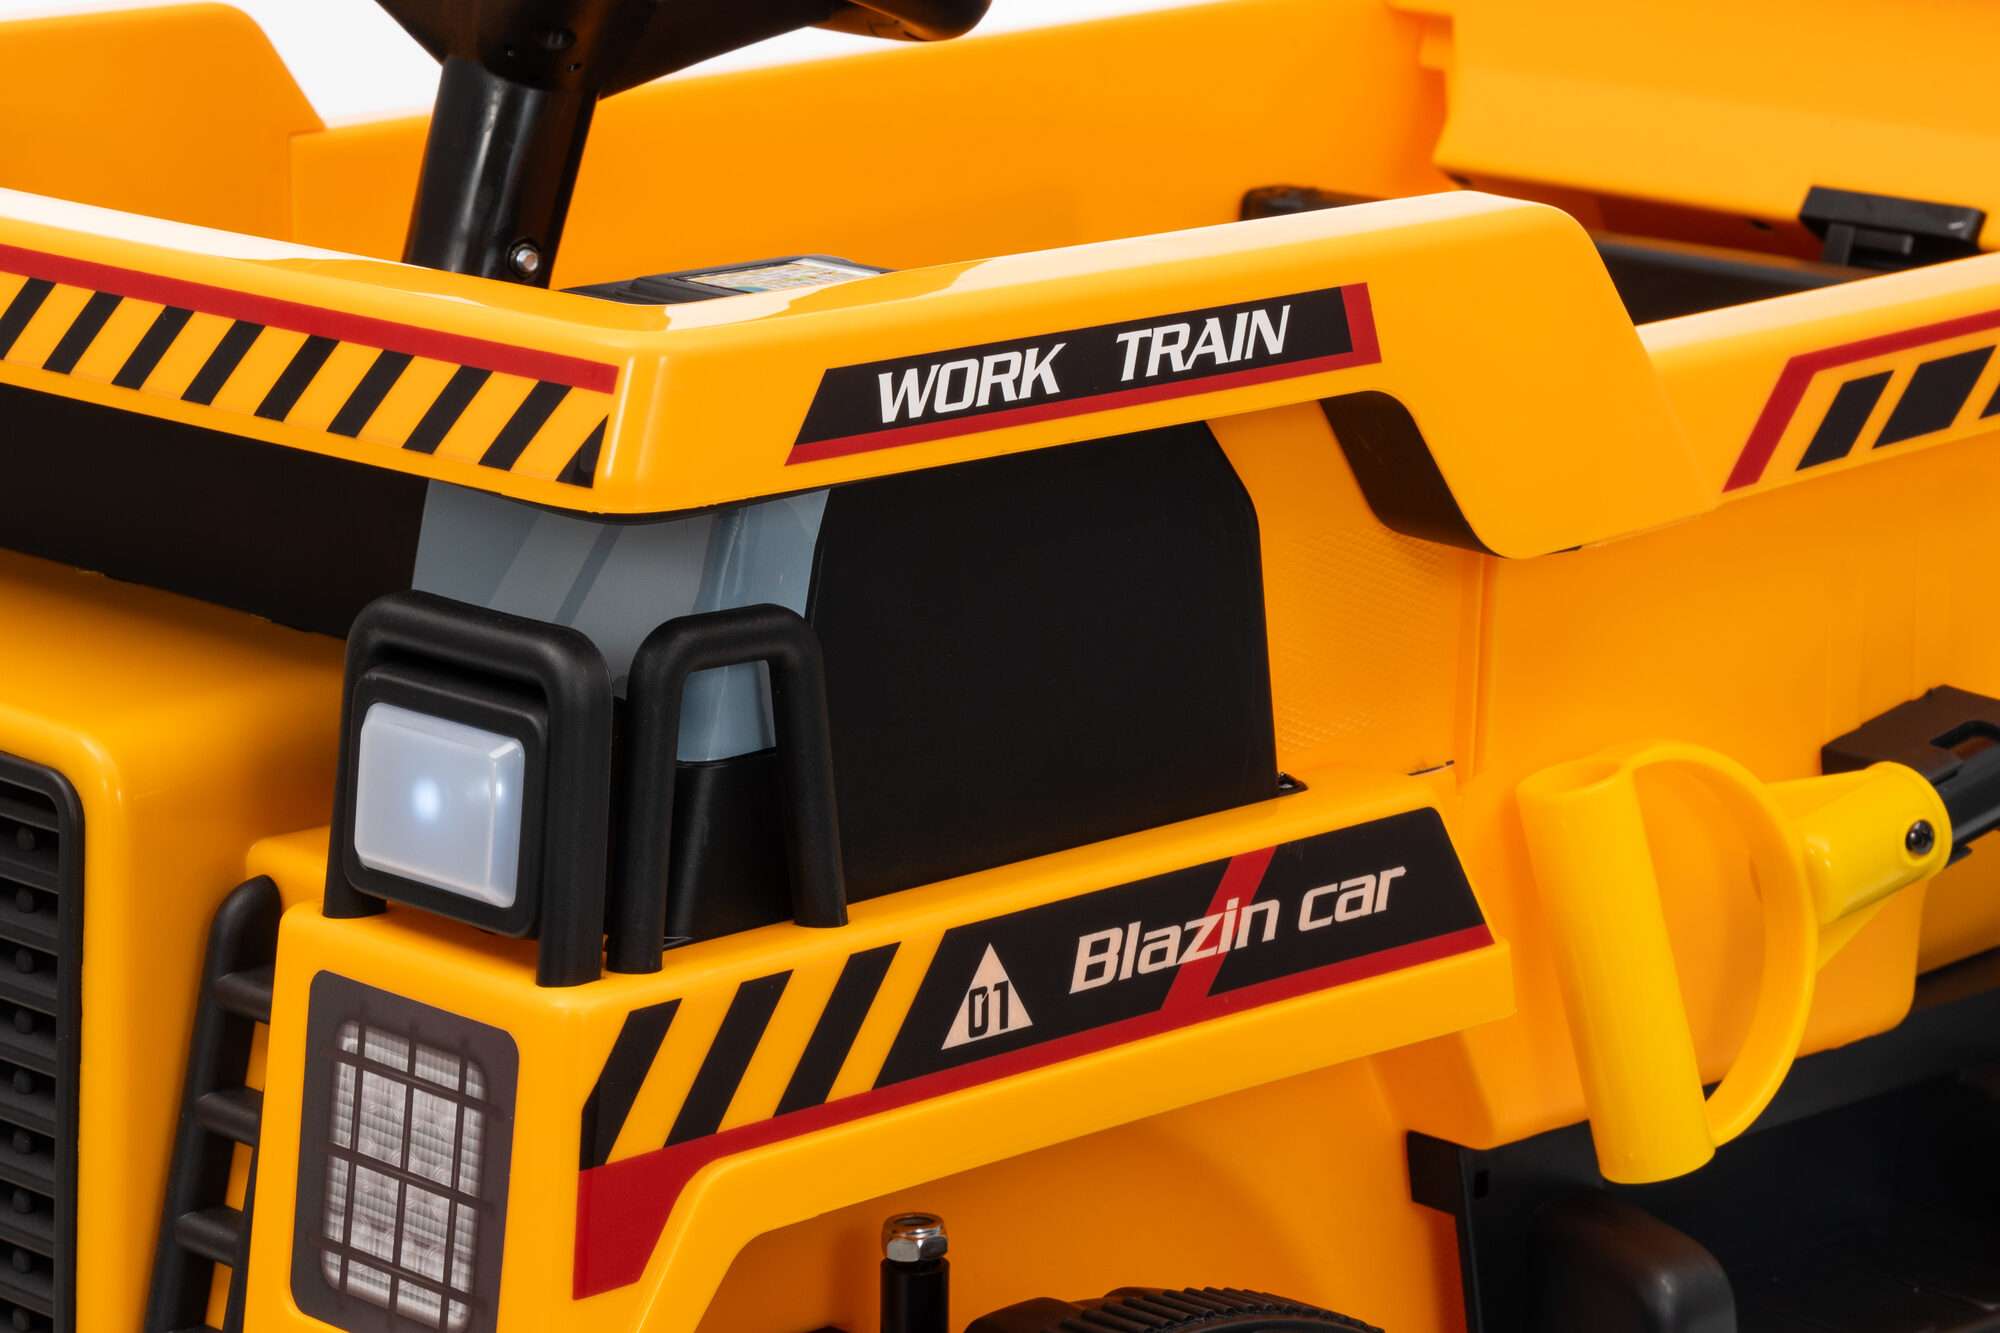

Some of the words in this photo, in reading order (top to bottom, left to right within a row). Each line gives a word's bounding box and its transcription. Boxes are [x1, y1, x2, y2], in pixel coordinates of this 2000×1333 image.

[877, 342, 1067, 424] WORK
[1115, 304, 1291, 382] TRAIN
[1068, 897, 1281, 995] Blazin
[1297, 865, 1407, 932] car
[967, 979, 1011, 1040] 01
